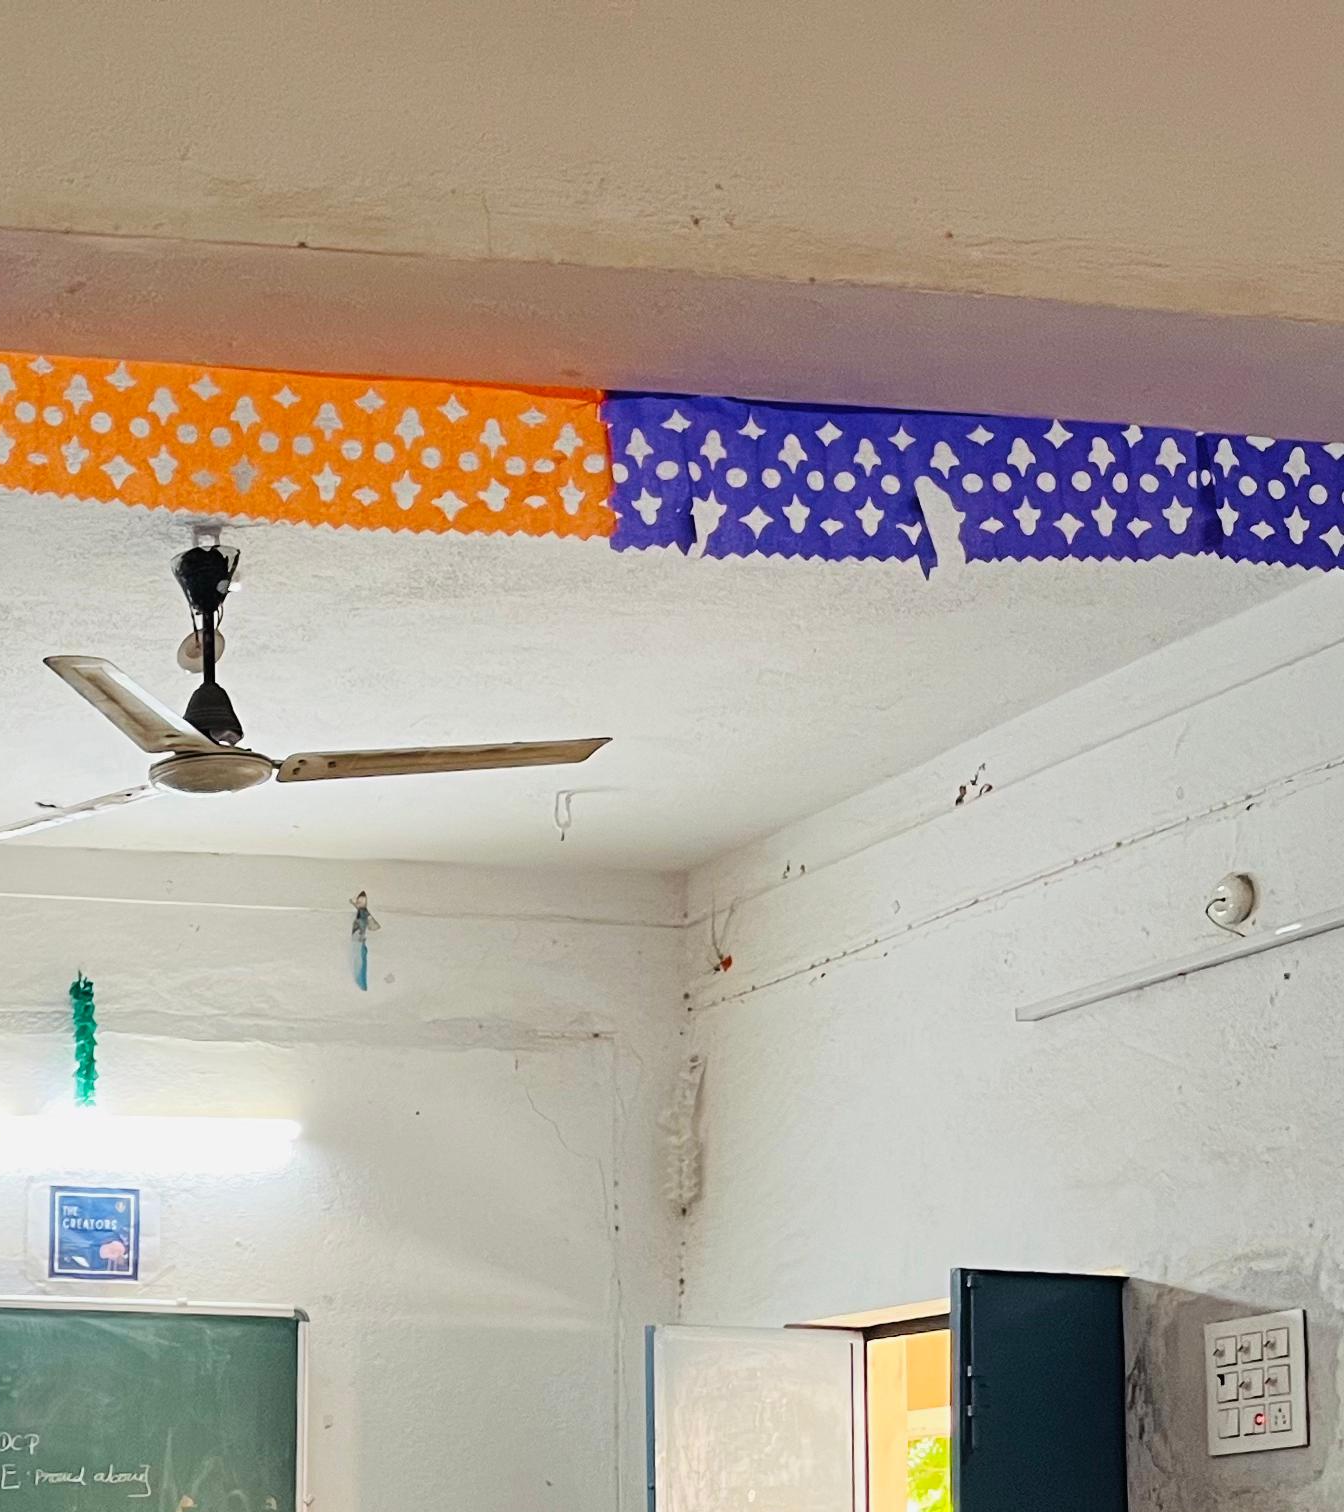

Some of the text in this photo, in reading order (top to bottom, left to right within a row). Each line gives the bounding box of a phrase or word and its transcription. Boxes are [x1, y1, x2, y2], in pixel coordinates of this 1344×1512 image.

[62, 1205, 79, 1217] THE
[62, 1218, 118, 1231] CREATORS
[0, 1432, 40, 1455] DCP
